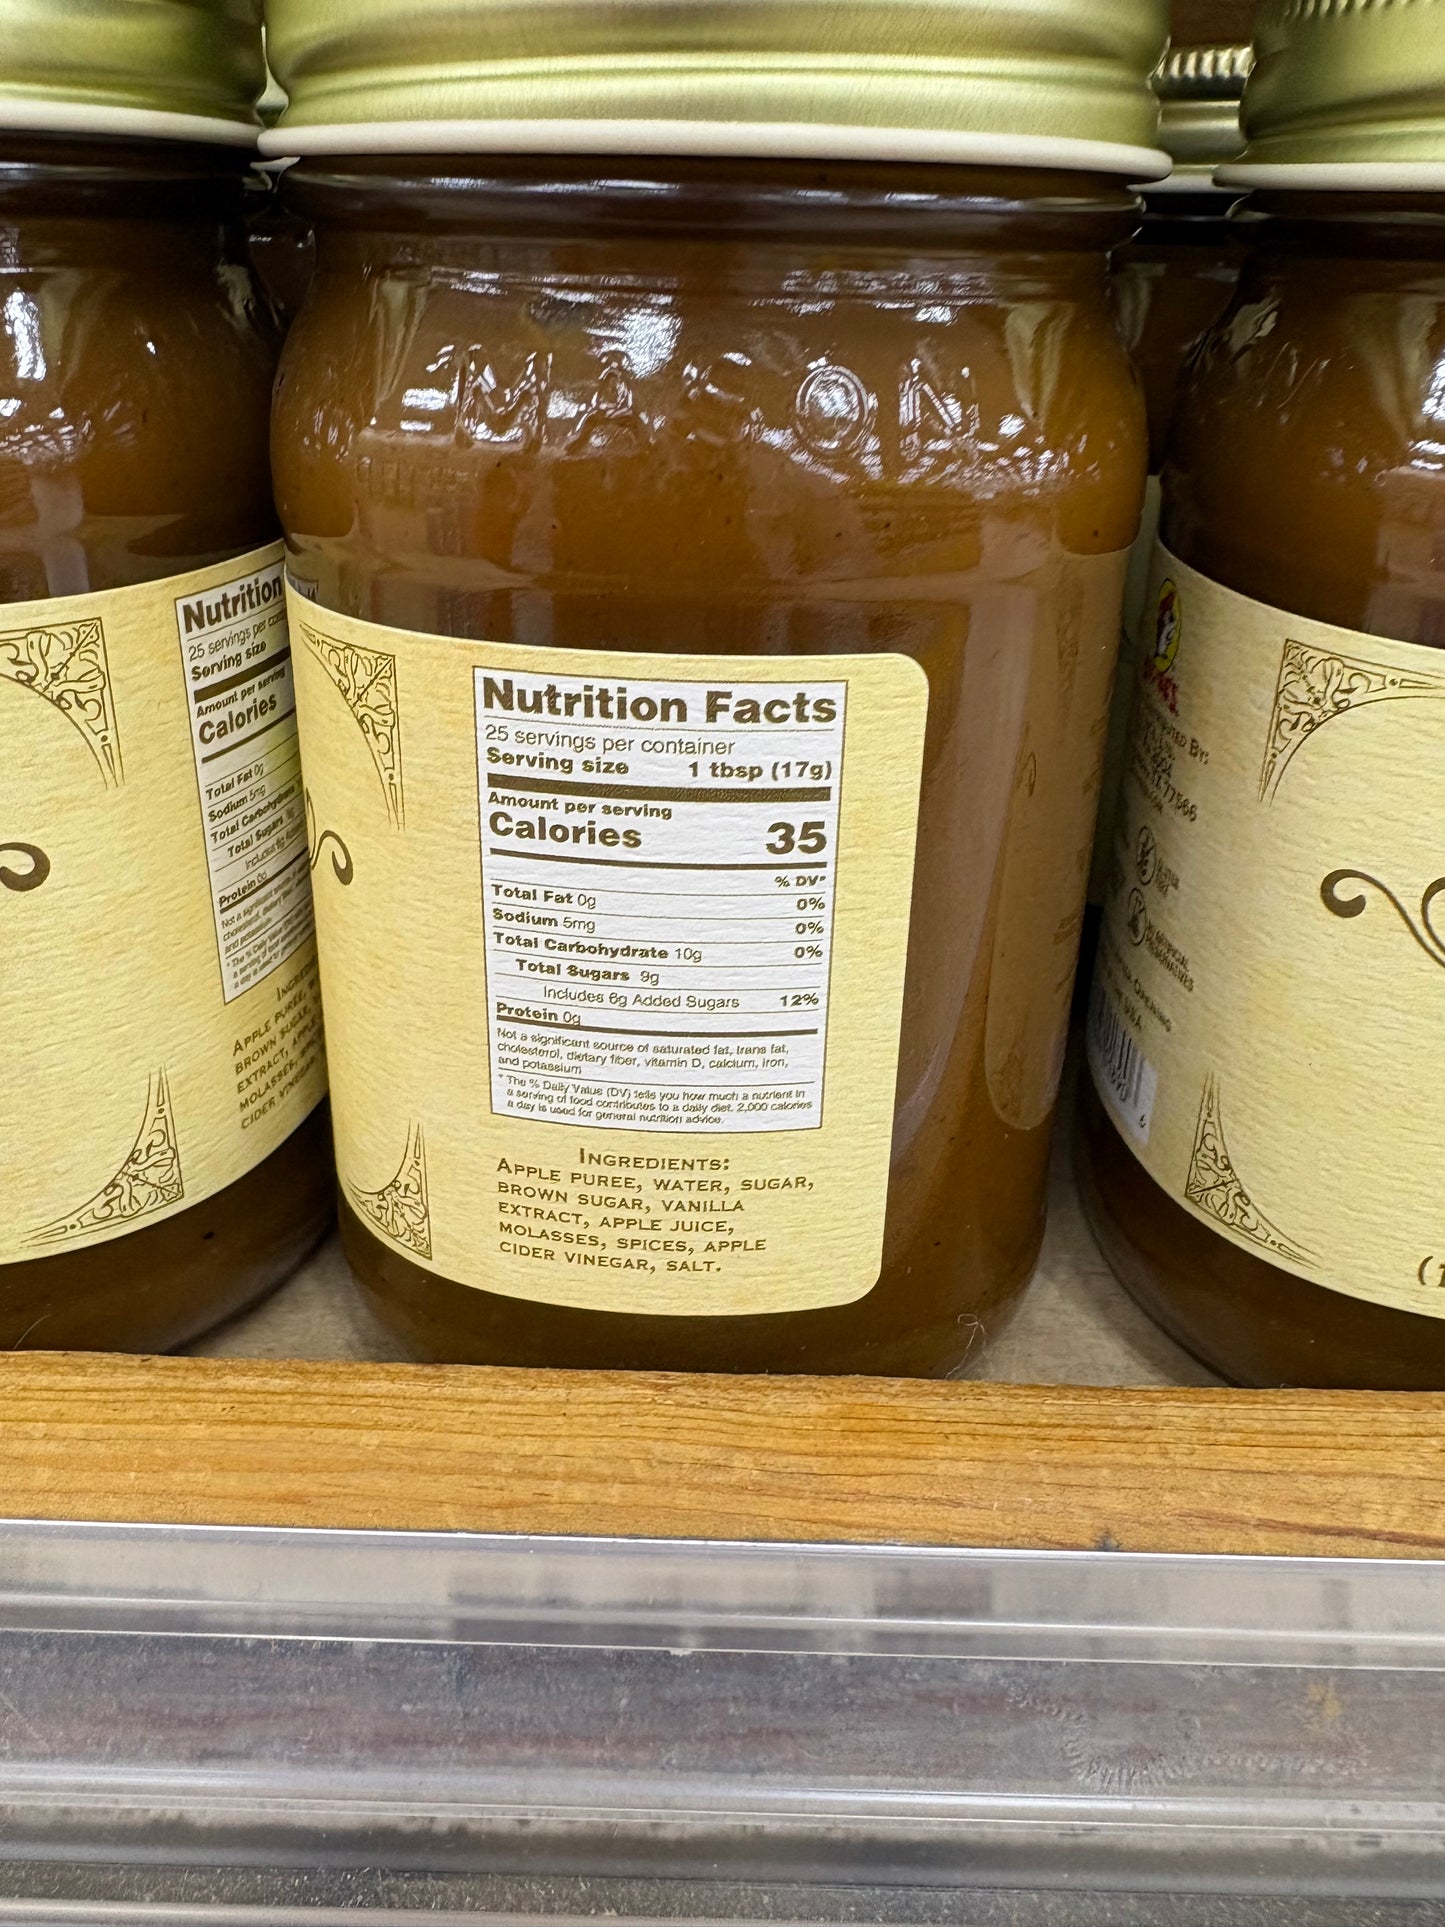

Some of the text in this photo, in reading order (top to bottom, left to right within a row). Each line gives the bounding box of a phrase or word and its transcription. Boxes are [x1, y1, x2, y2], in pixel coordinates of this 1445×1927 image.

[183, 576, 282, 634] Nutrition
[208, 628, 251, 655] servings
[191, 641, 267, 681] Serving size
[197, 691, 238, 719] Amount
[241, 684, 255, 701] per
[483, 677, 837, 724] Nutrition Facts
[199, 694, 277, 744] Calories
[485, 724, 736, 755] 25 servings per container
[486, 746, 630, 775] Serving size
[688, 760, 832, 782] 1 tbsp (17g)
[205, 778, 235, 800] Total
[237, 769, 253, 785] Fat
[208, 796, 248, 823] Sodium
[488, 791, 672, 820] Amount per serving
[210, 820, 239, 844] Total
[489, 811, 642, 848] Calories
[765, 820, 828, 855] 35
[227, 834, 254, 858] Total
[218, 878, 256, 908] Protein
[491, 883, 597, 909] Total Fat 0g
[796, 896, 826, 911] 0%
[492, 907, 596, 934] Sodium 5mg
[794, 920, 824, 935] 0%
[493, 931, 702, 963] Total Carbohydrate 10g
[793, 944, 823, 958] 0%
[515, 958, 660, 986] Total Sugars 9g
[543, 985, 605, 1003] Includes
[632, 993, 681, 1008] Added
[686, 995, 740, 1011] Sugars
[779, 992, 819, 1007] 12%
[496, 1001, 581, 1026] Protein 0g
[233, 1019, 272, 1057] APPLE
[497, 1027, 516, 1040] Not
[531, 1033, 590, 1048] significant
[593, 1041, 634, 1052] source
[637, 1043, 649, 1053] of
[653, 1044, 710, 1055] saturated
[713, 1044, 733, 1056] fat,
[736, 1045, 767, 1055] trans
[770, 1043, 789, 1055] fat,
[235, 1034, 277, 1075] BROWN
[497, 1042, 789, 1070] cholesterol, dietary fiber, vitamin D, calcium, iron,
[498, 1056, 582, 1074] and potassium
[237, 1047, 289, 1094] EXTRACT,
[507, 1075, 526, 1087] The
[543, 1080, 570, 1093] Daily
[572, 1084, 603, 1096] Value
[607, 1087, 631, 1099] (DV)
[659, 1092, 680, 1102] you
[682, 1091, 705, 1101] how
[709, 1091, 739, 1101] much
[752, 1090, 793, 1100] nutrient
[516, 1090, 554, 1103] serving
[570, 1095, 593, 1106] food
[595, 1099, 656, 1111] contributes
[658, 1103, 669, 1111] to
[682, 1102, 708, 1114] daily
[770, 1100, 813, 1111] calories
[240, 1096, 276, 1130] CIDER
[516, 1101, 535, 1112] day
[550, 1105, 575, 1116] used
[578, 1107, 593, 1117] for
[595, 1111, 636, 1121] general
[639, 1114, 683, 1123] nutrition
[580, 1148, 729, 1171] INGREDIENTS:
[497, 1158, 814, 1195] APPLE PUREE, WATER, SUGAR,
[498, 1182, 745, 1214] BROWN SUGAR, VANILLA
[498, 1202, 734, 1235] EXTRACT, APPLE JUICE,
[499, 1221, 767, 1255] MOLASSES, SPICES, APPLE
[500, 1241, 721, 1274] CIDER VINEGAR, SALT.
